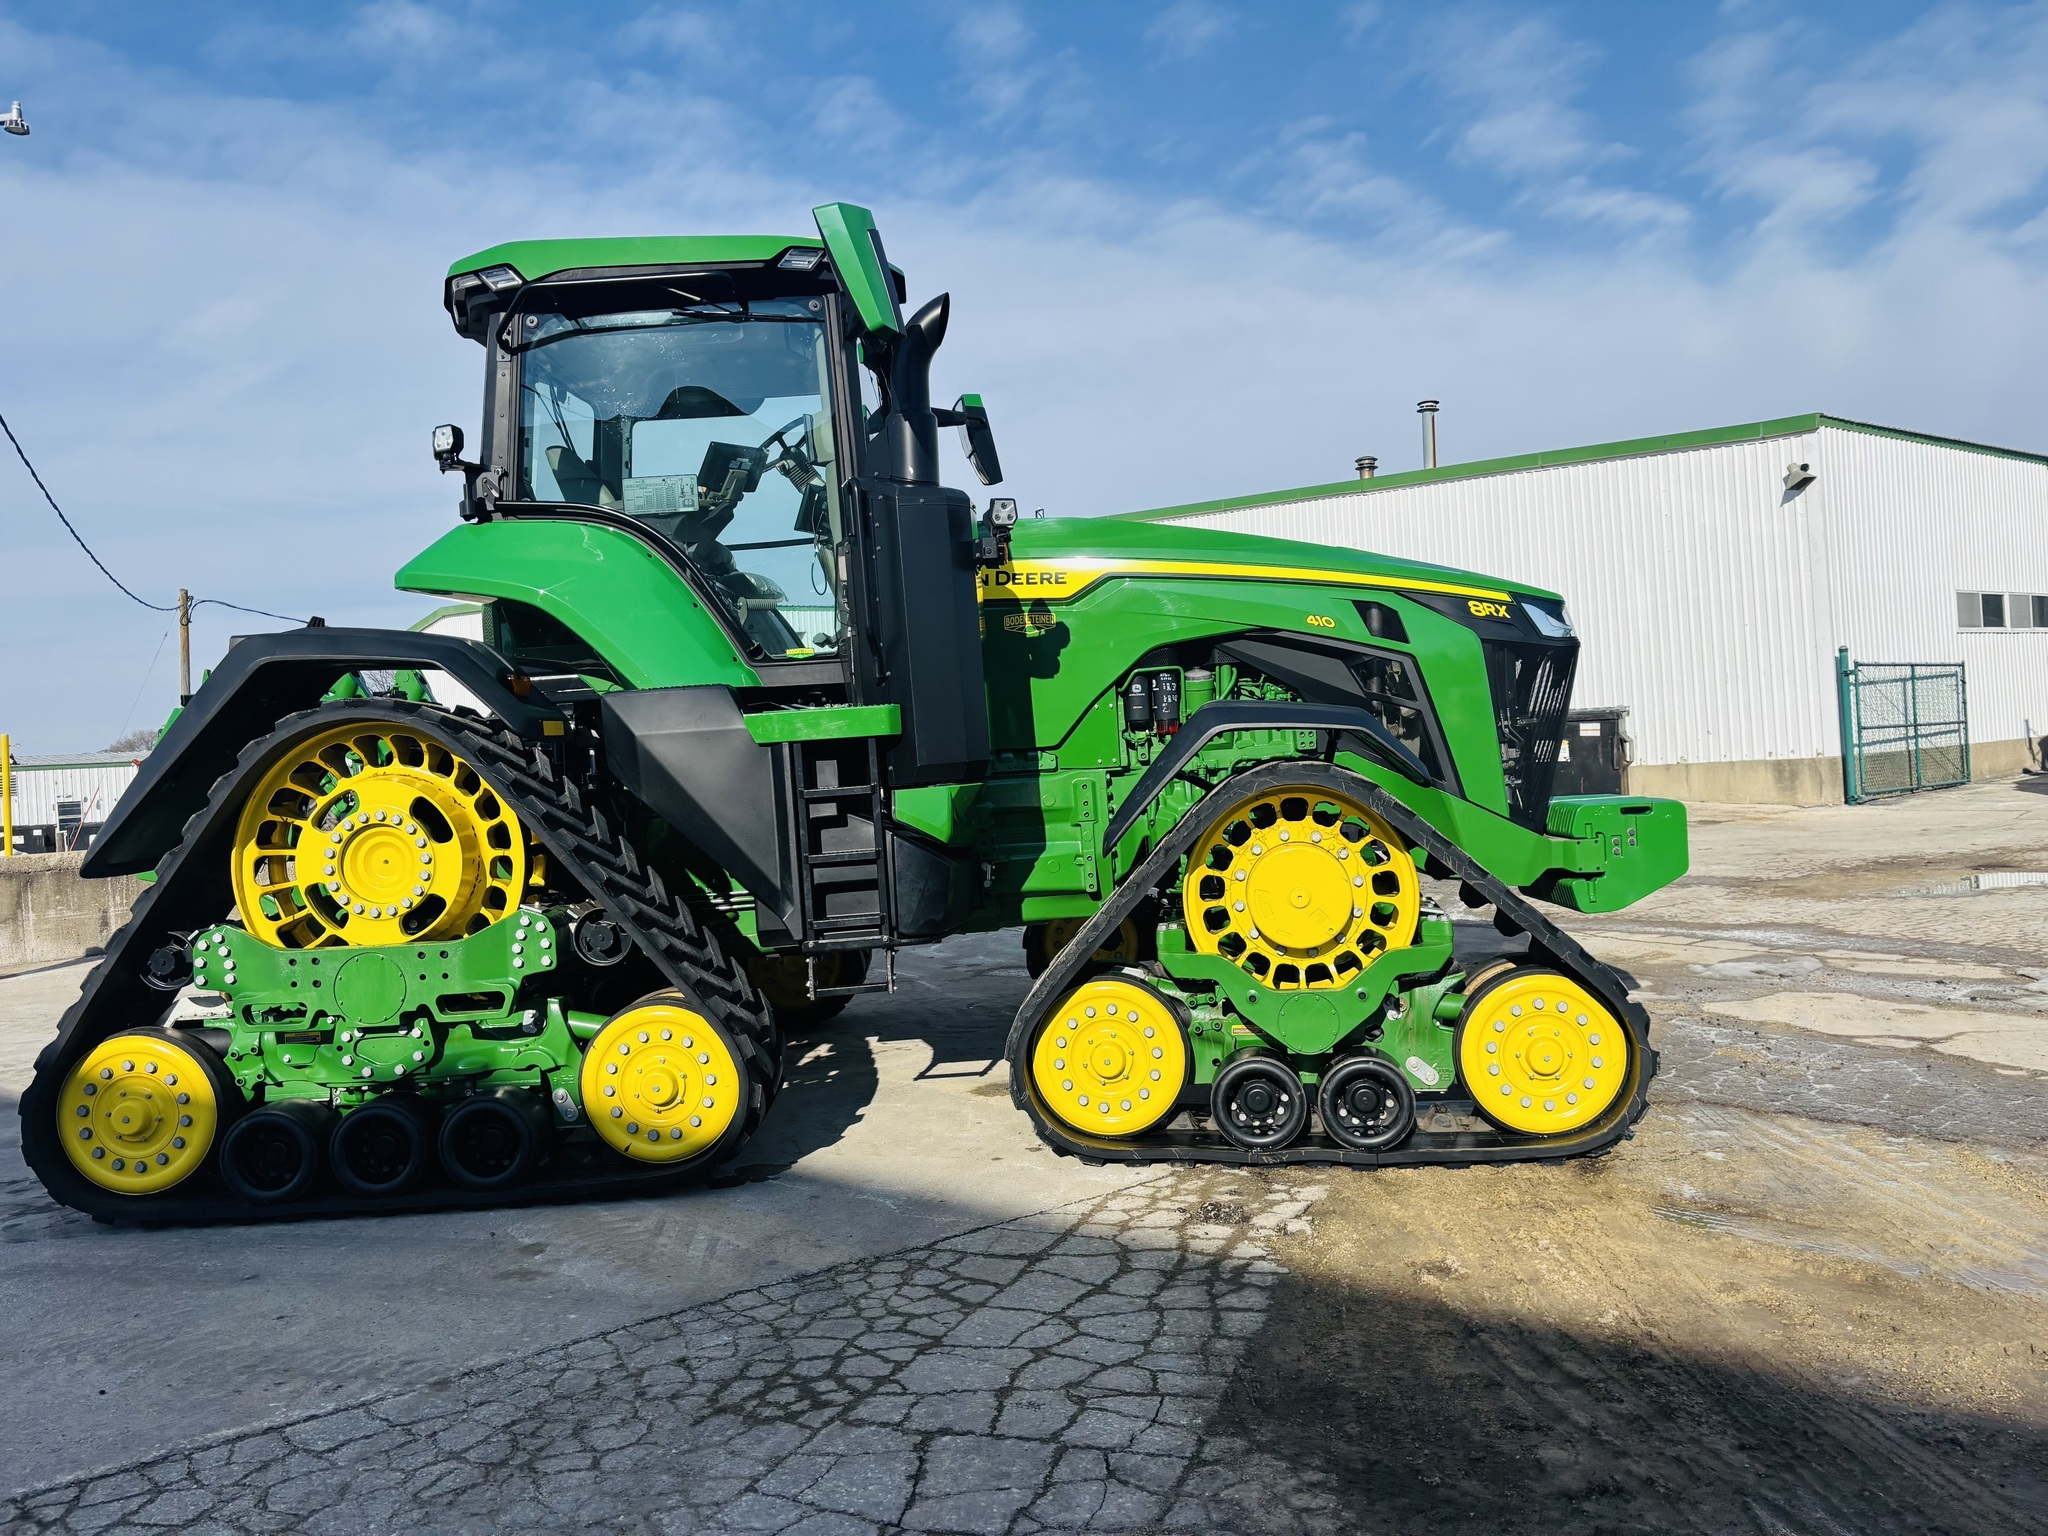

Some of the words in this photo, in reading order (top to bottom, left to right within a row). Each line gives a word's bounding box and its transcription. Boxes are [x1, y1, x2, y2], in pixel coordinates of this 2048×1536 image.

[995, 570, 1067, 586] DEERE
[1467, 600, 1512, 619] 8RX
[1306, 614, 1336, 628] 410
